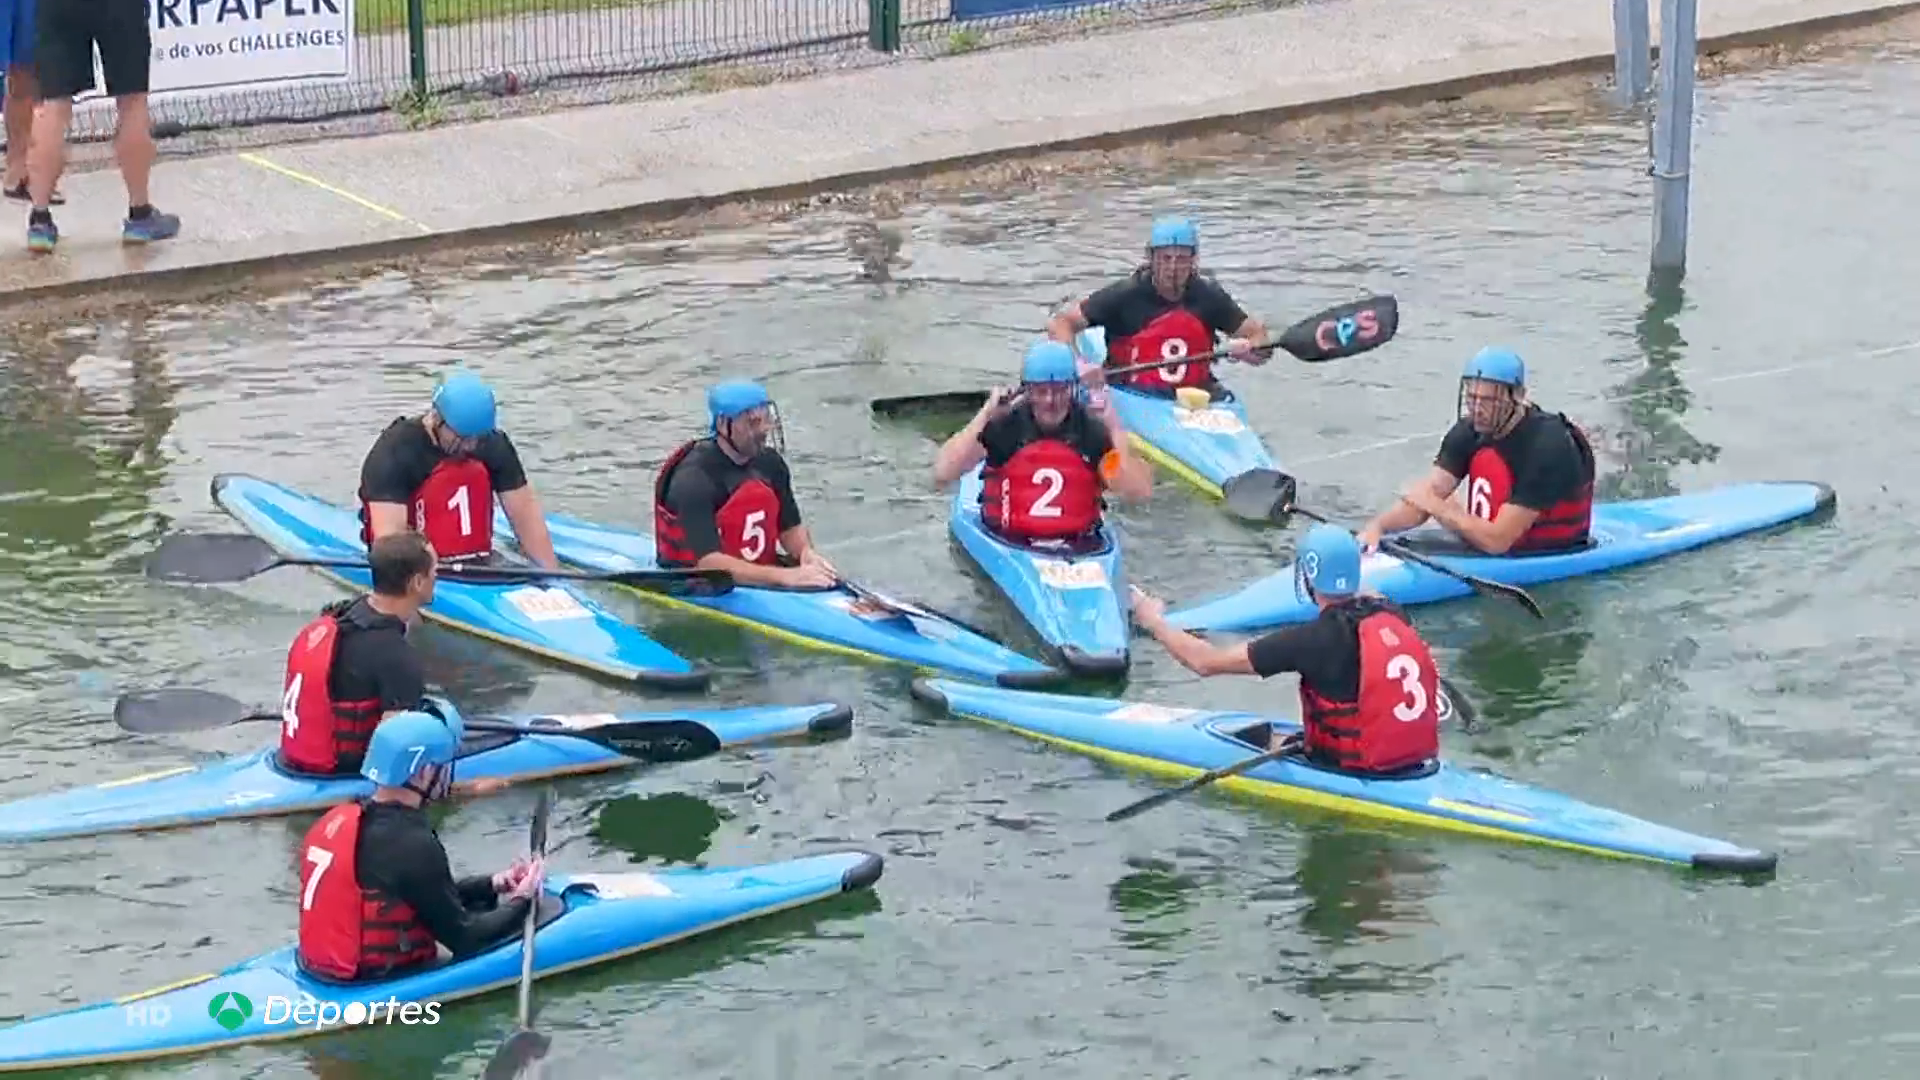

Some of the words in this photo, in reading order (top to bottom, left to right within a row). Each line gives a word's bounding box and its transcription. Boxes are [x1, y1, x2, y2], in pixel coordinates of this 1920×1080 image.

[168, 42, 190, 60] de
[195, 42, 223, 57] vos
[228, 29, 345, 54] CHALLENGES
[1158, 337, 1188, 383] 8
[447, 484, 473, 537] 1
[1028, 467, 1064, 517] 2
[1470, 476, 1493, 524] 6
[740, 509, 766, 561] 5
[1305, 550, 1320, 578] 3
[282, 671, 304, 740] 4
[1386, 653, 1428, 722] 3
[408, 745, 426, 774] 7
[302, 844, 334, 912] 7
